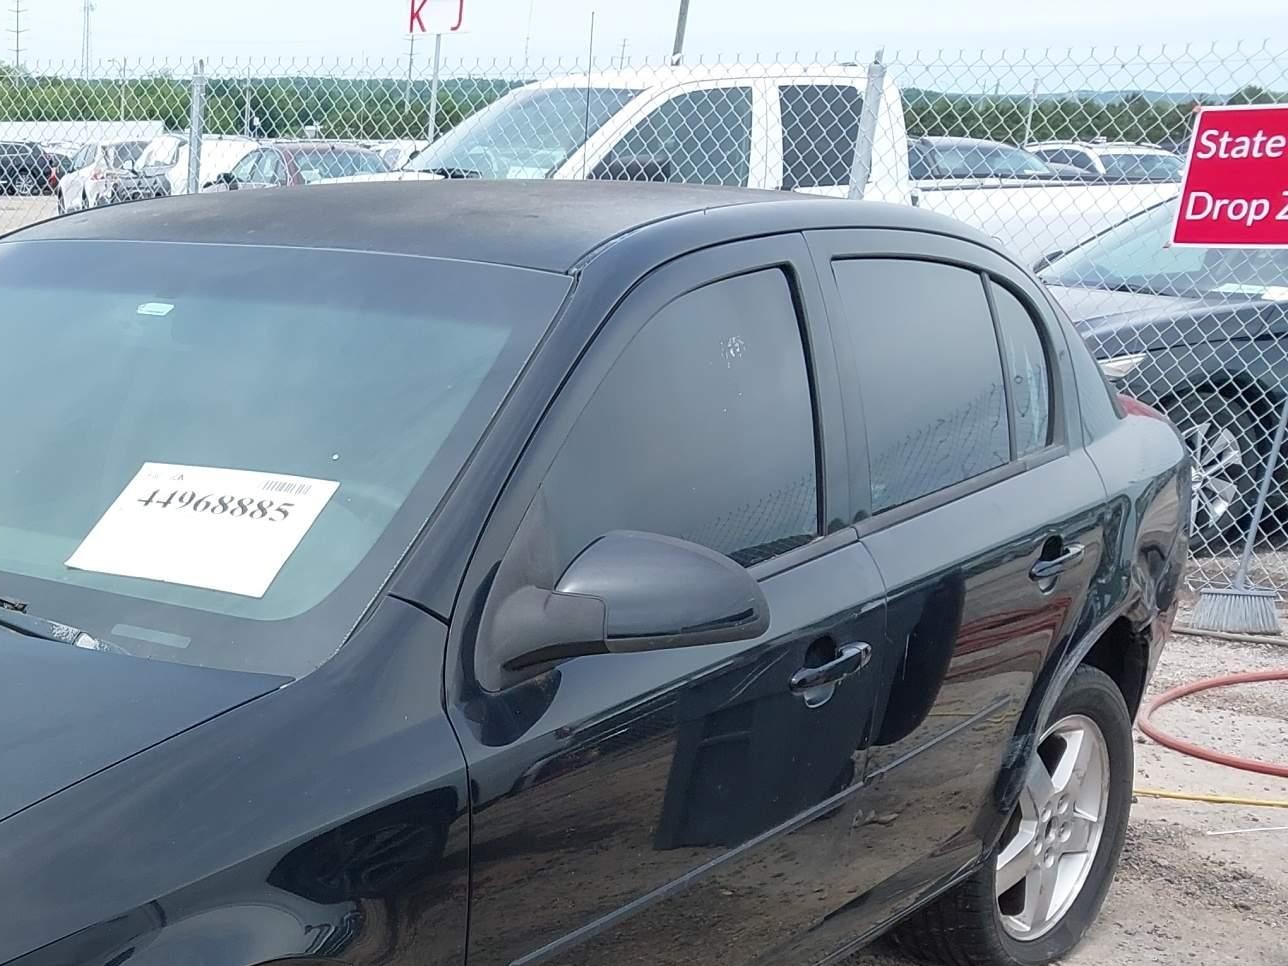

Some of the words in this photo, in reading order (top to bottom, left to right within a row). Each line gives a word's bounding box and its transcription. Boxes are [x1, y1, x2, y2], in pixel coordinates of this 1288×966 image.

[409, 0, 426, 33] K
[450, 0, 464, 31] J
[1196, 129, 1286, 159] State
[1185, 191, 1270, 227] Drop
[137, 489, 295, 522] 44968885
